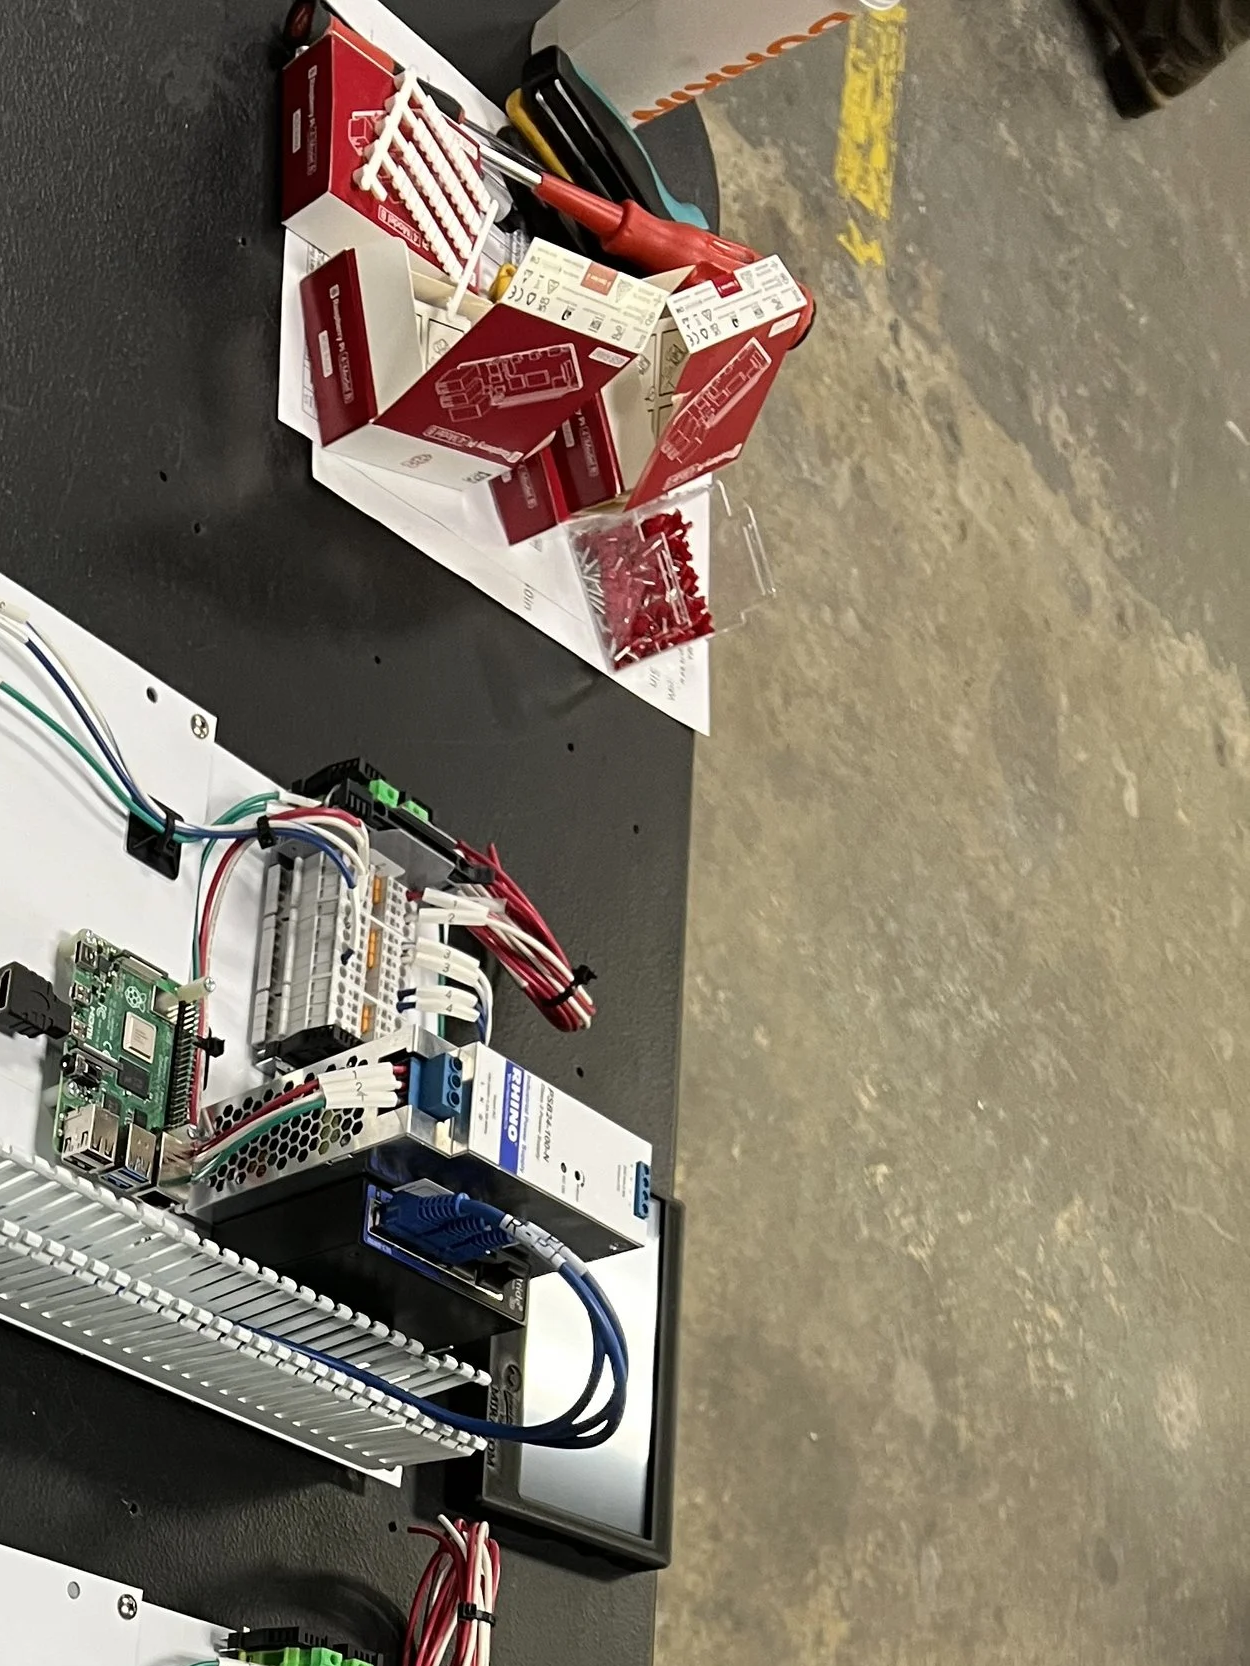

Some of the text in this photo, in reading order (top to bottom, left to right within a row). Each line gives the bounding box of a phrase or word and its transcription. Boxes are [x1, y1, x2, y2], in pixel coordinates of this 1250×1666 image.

[331, 298, 343, 341] Raspberry
[448, 913, 455, 923] 2
[443, 949, 451, 959] 3
[442, 963, 450, 973] 3
[445, 990, 452, 999] 4
[445, 1004, 453, 1012] 4
[352, 1070, 357, 1079] 1
[355, 1081, 363, 1092] 2
[508, 1066, 523, 1143] RHINO
[487, 1385, 499, 1468] MIROM
